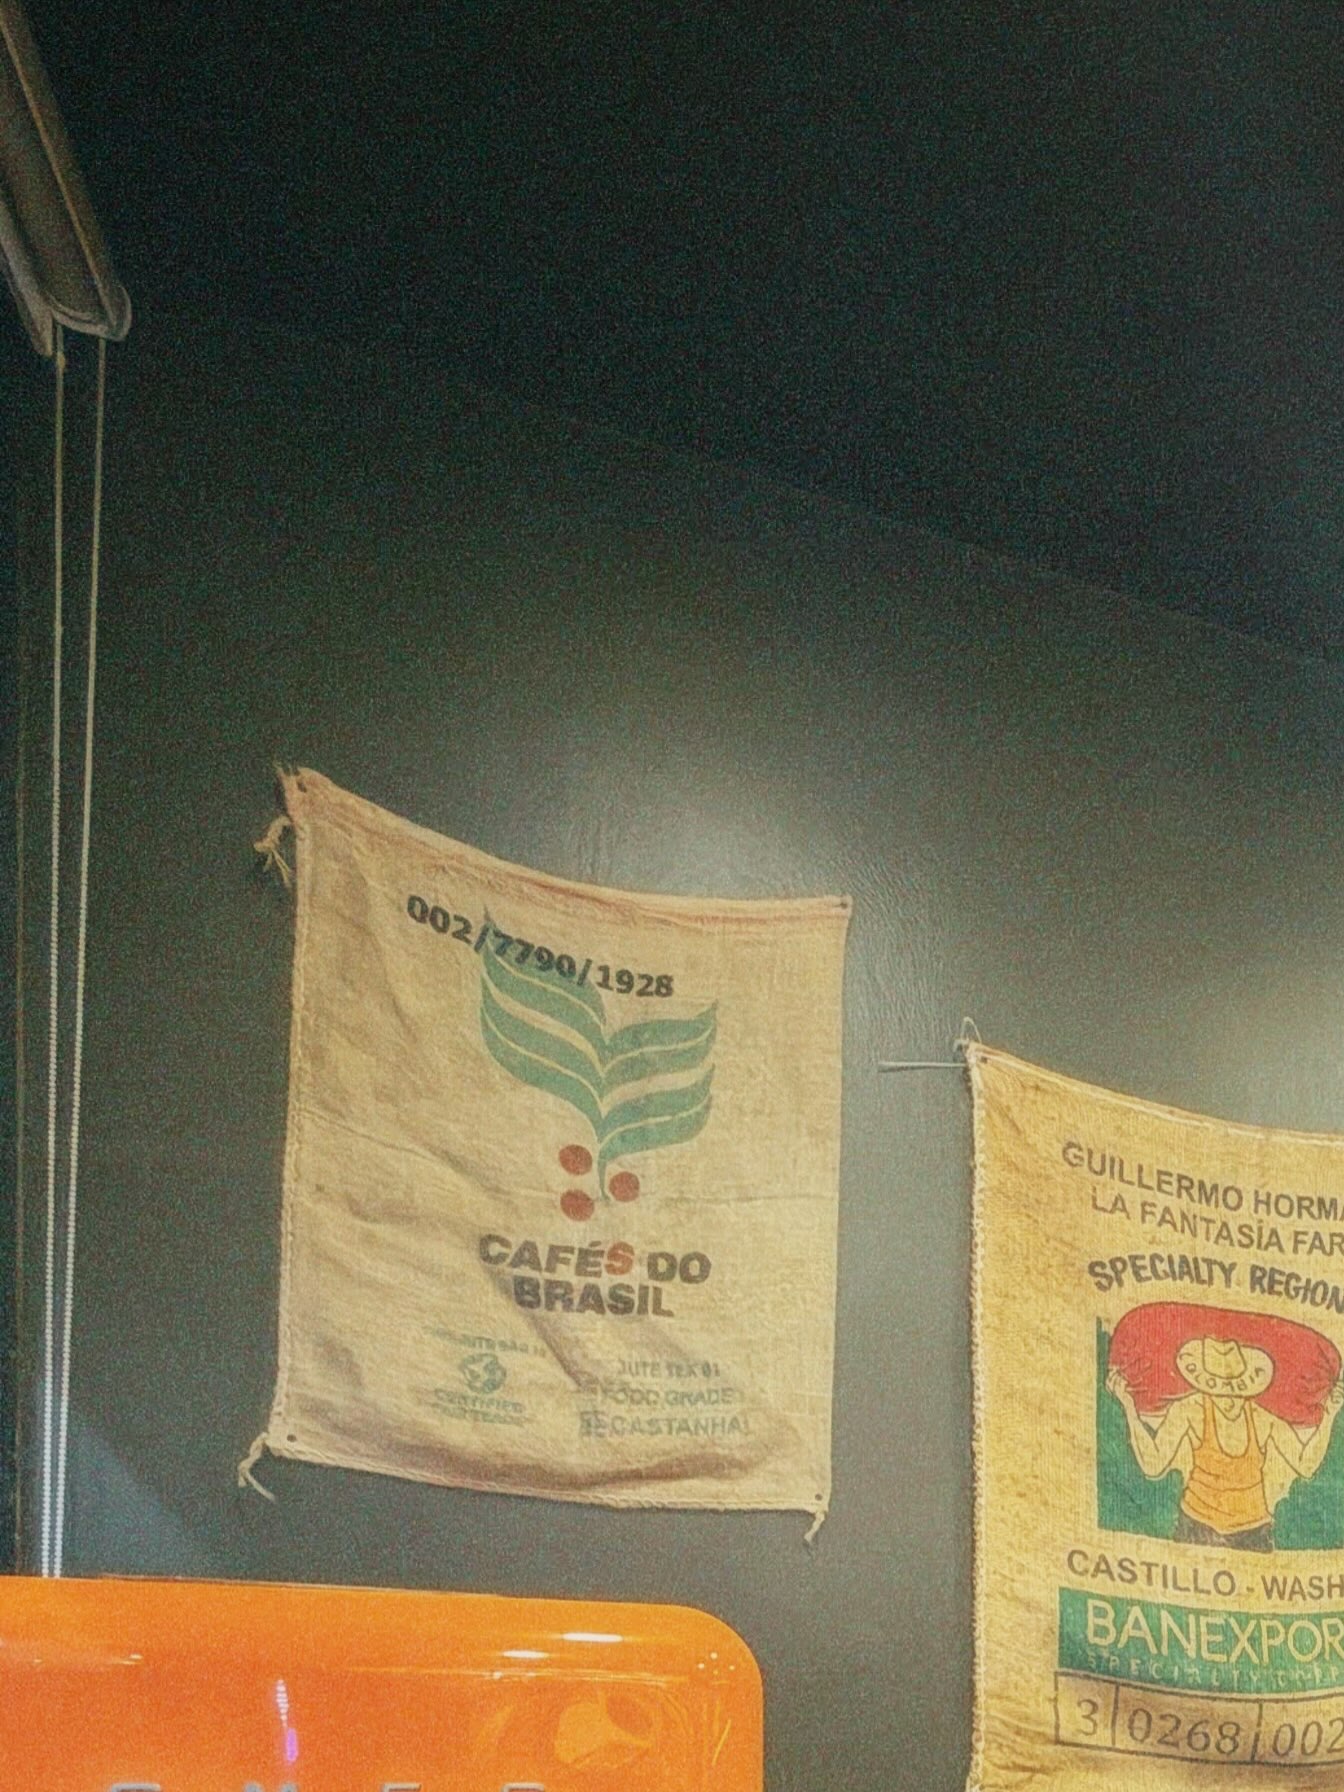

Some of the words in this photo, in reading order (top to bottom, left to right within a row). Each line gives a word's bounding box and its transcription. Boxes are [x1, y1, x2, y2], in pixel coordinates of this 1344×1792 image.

[407, 894, 674, 998] 002/7790/1928
[1062, 1140, 1244, 1213] GUILLERMO
[1091, 1185, 1131, 1220] LA
[479, 1233, 636, 1278] CAFÉS
[648, 1251, 712, 1285] DO
[1087, 1253, 1238, 1293] SPECIALTY
[513, 1274, 675, 1318] BRASIL
[1067, 1549, 1236, 1597] CASTILLO
[1076, 1699, 1099, 1737] 3
[1127, 1708, 1241, 1756] 0268
